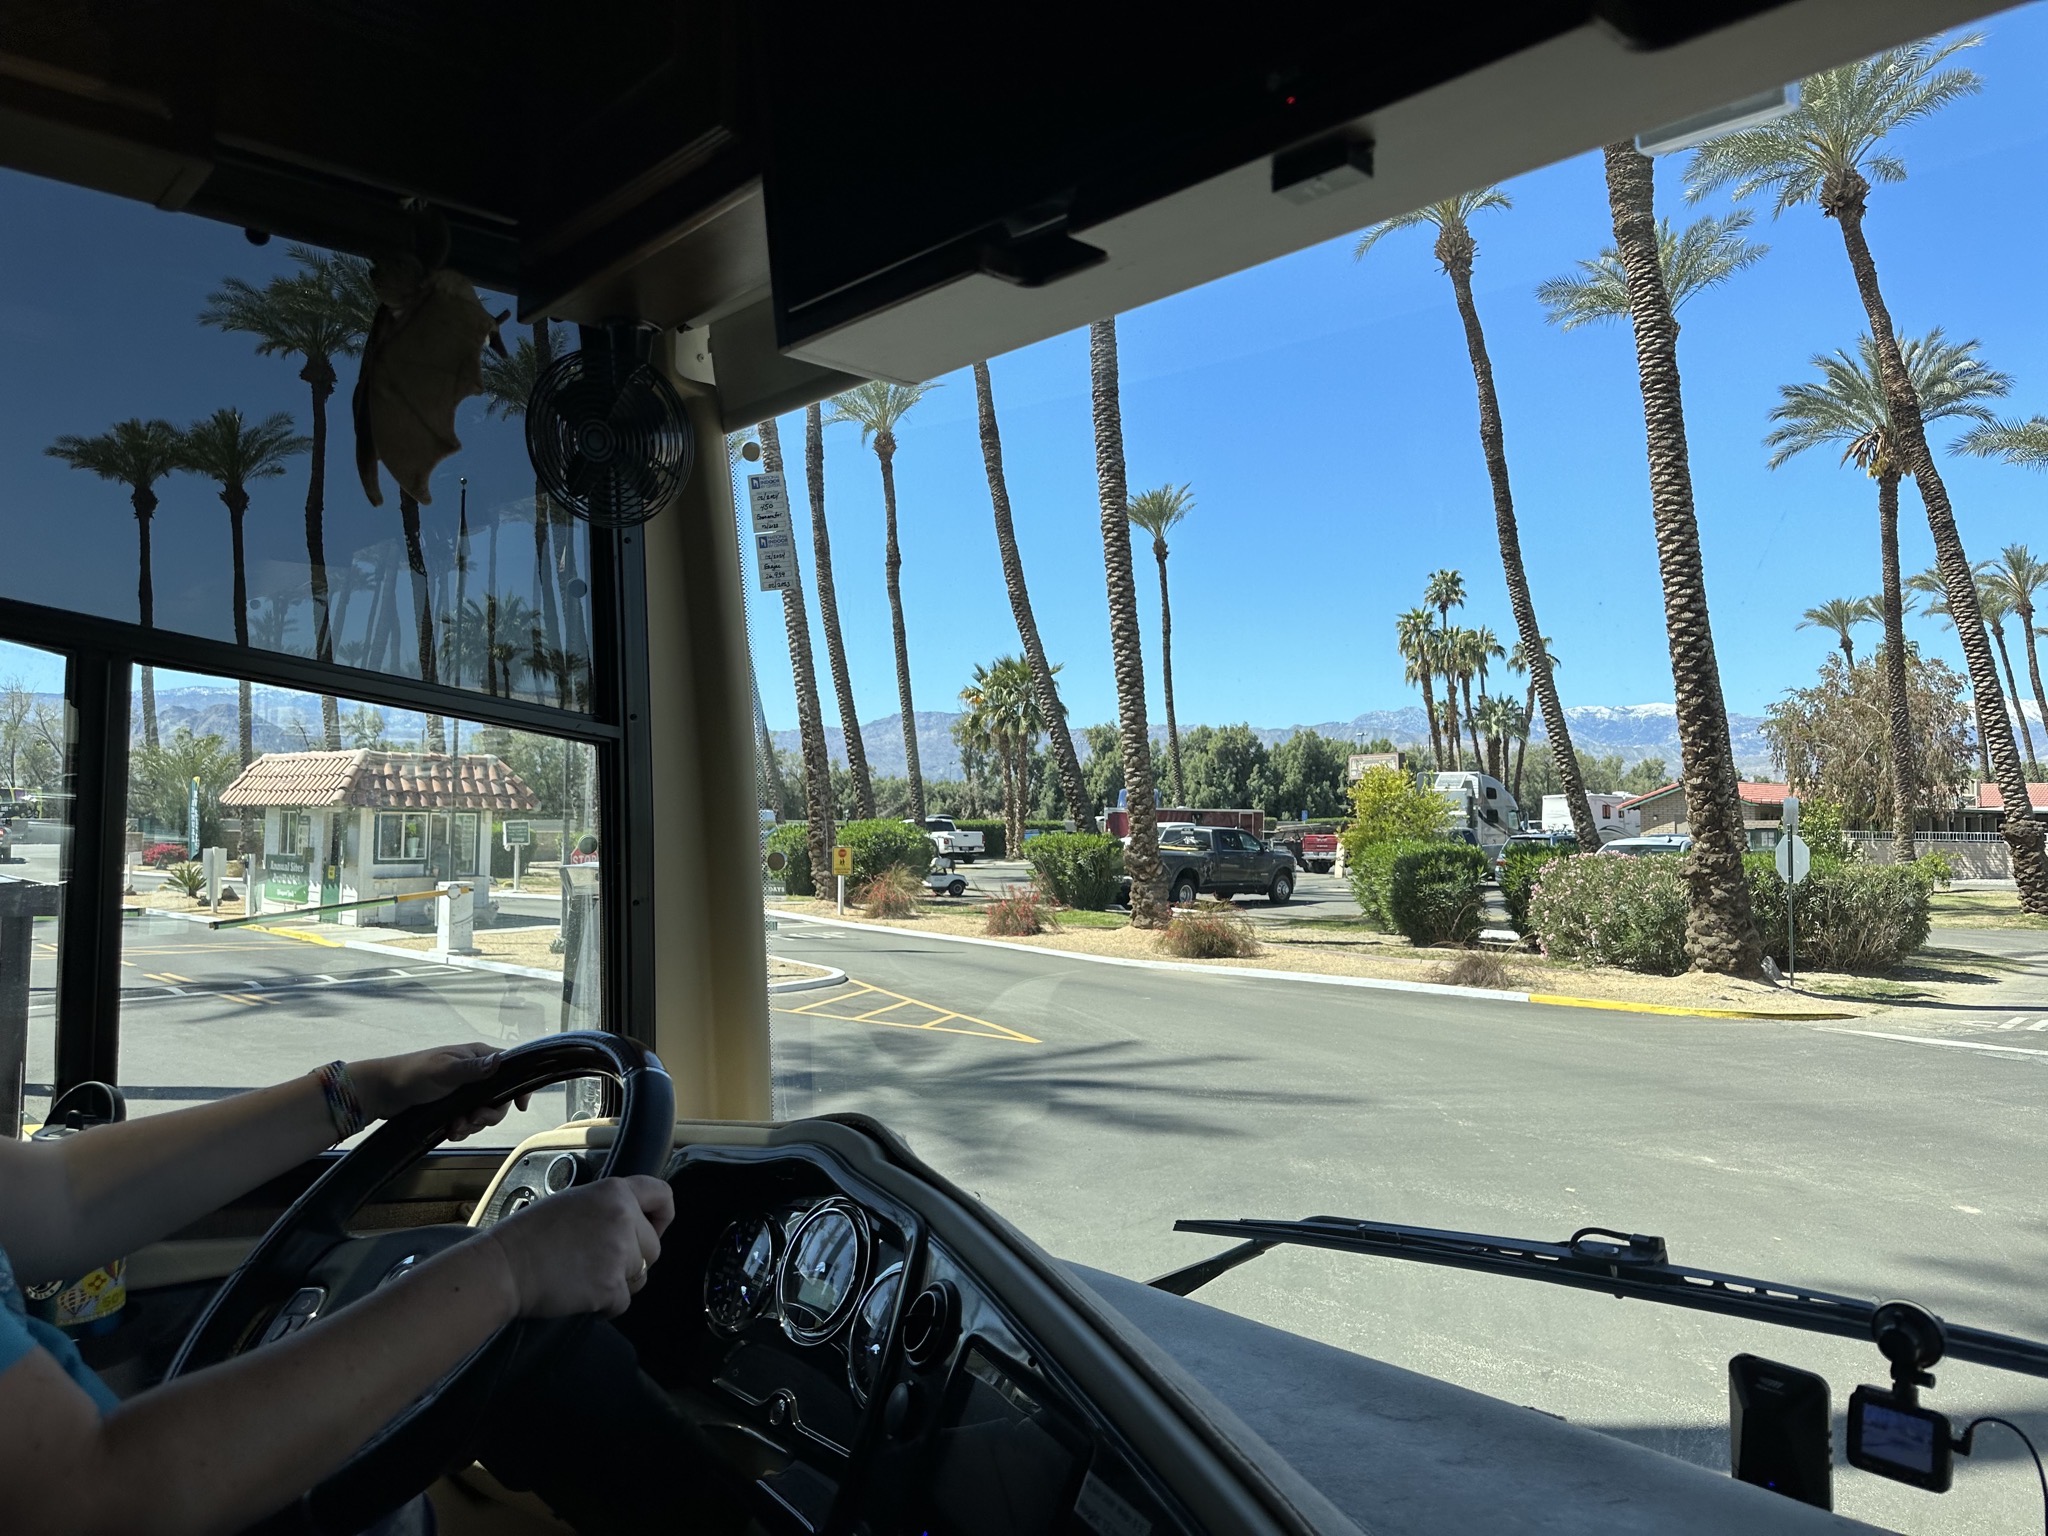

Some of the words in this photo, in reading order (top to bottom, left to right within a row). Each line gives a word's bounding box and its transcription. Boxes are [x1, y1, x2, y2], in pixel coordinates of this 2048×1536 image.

[572, 854, 598, 864] STOP
[270, 860, 290, 871] Annual
[290, 861, 304, 873] Sites
